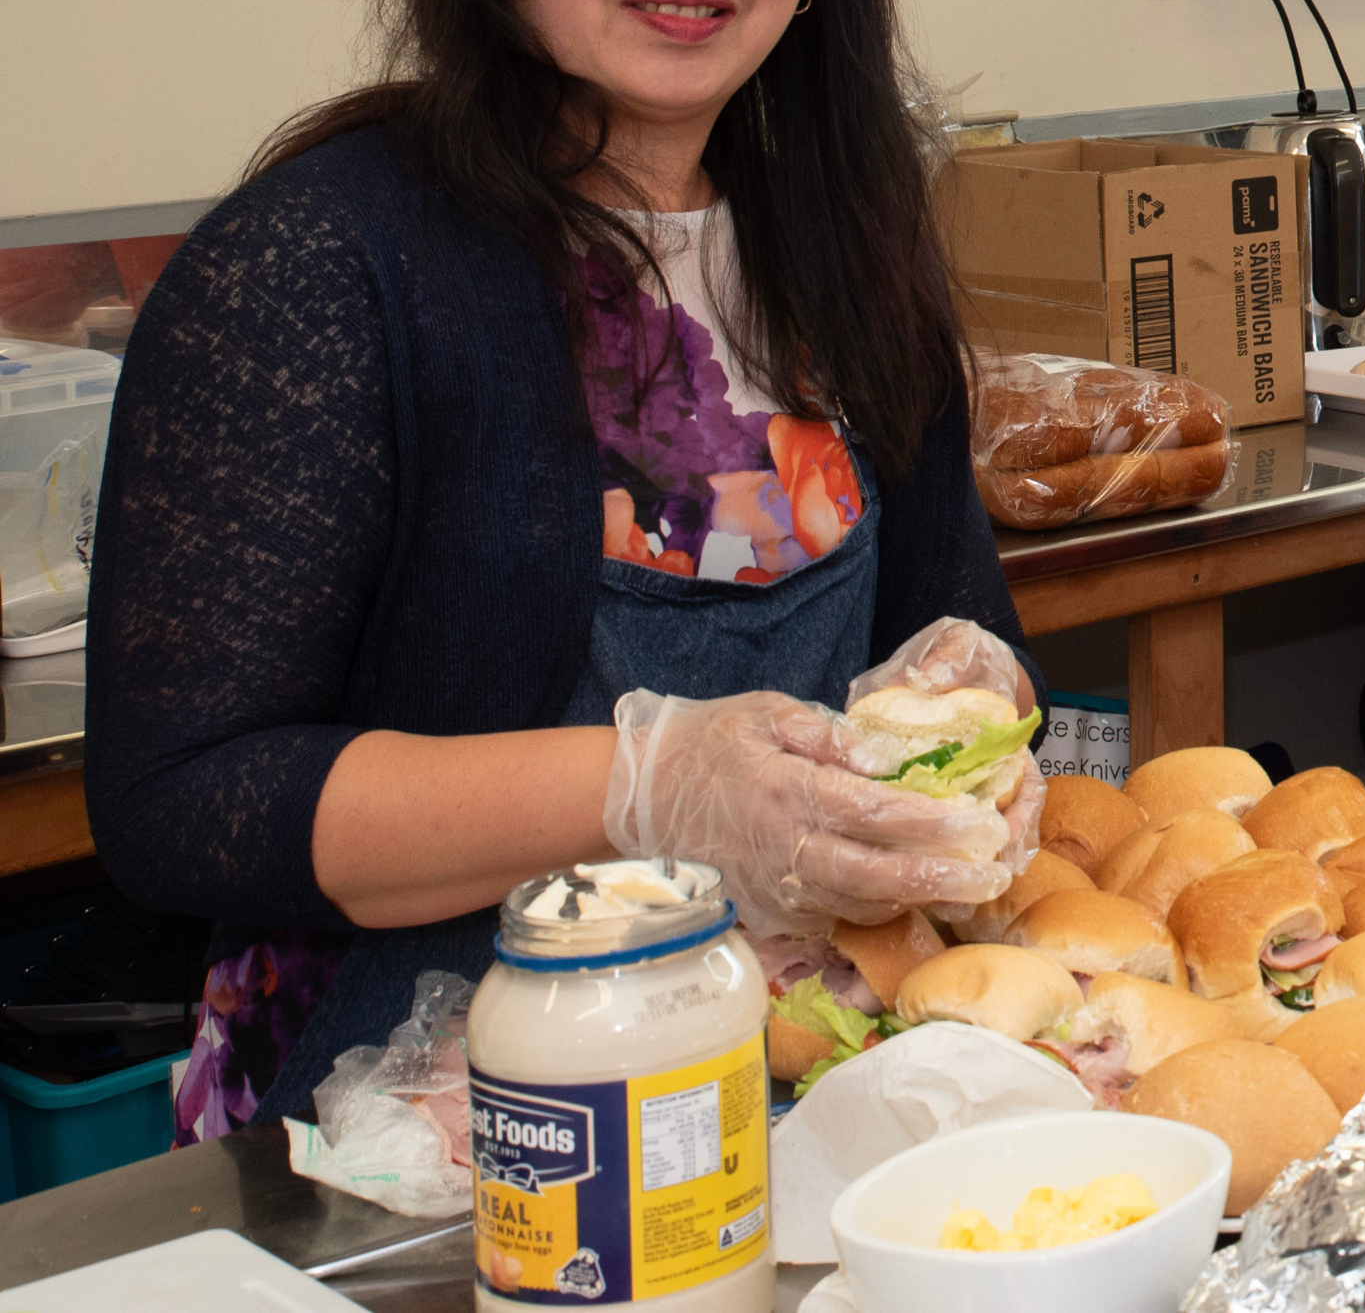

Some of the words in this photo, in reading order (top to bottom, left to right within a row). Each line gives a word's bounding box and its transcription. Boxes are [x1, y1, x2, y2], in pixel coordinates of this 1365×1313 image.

[1127, 189, 1135, 235] CARDBOARD
[1239, 187, 1251, 225] pams
[1233, 245, 1244, 257] 24
[1234, 269, 1245, 283] 30
[1270, 240, 1283, 304] RESEALABLE
[1235, 285, 1246, 327] MEDIUM
[1249, 242, 1273, 347] SANDWICH
[1236, 329, 1248, 356] BAGS
[1254, 352, 1275, 404] BAGS
[1075, 718, 1130, 743] Slicers
[1080, 757, 1130, 781] Knive
[495, 1111, 576, 1154] Foods
[480, 1189, 531, 1225] REAL
[478, 1216, 554, 1243] YONNAISE
